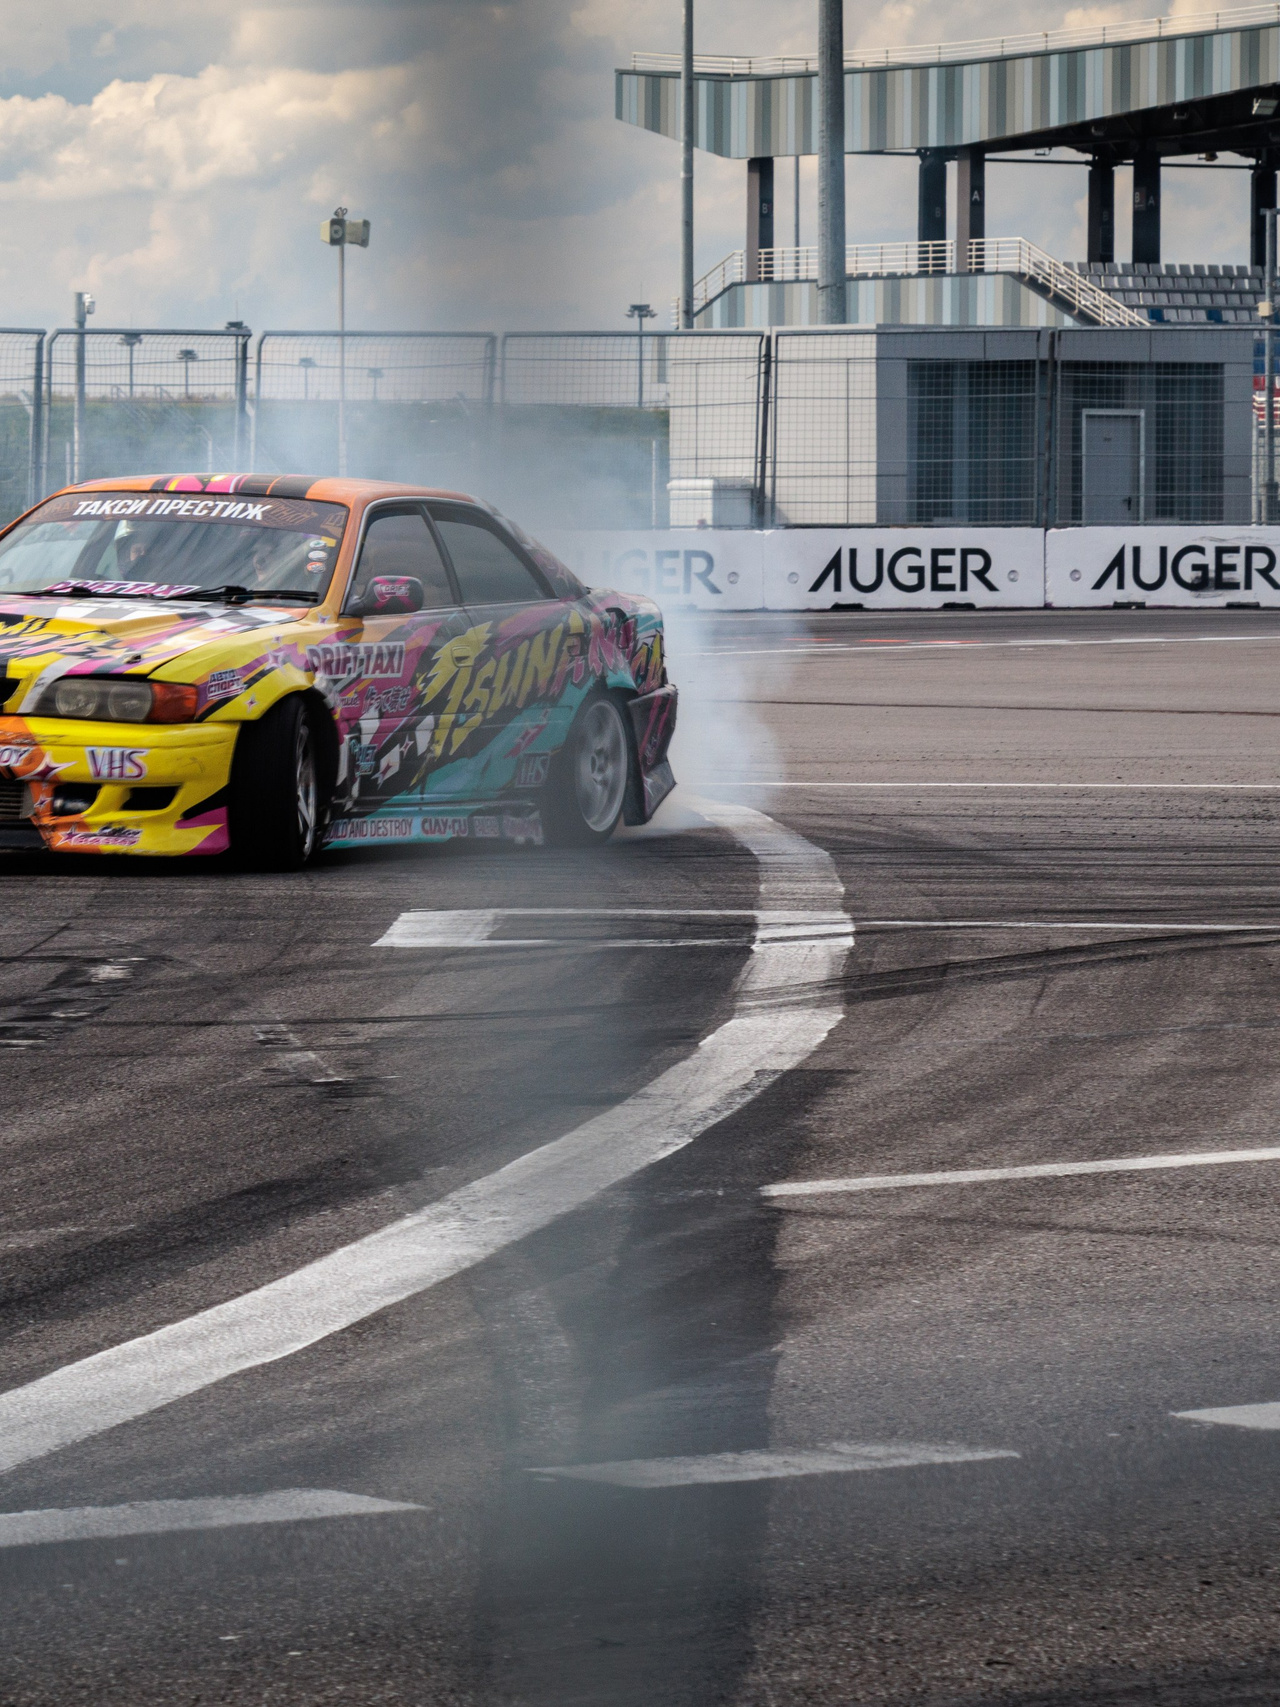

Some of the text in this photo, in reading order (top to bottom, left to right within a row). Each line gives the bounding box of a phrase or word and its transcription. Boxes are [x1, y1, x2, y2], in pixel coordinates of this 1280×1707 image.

[72, 499, 147, 517] ТАКСИ
[145, 498, 272, 521] ПРЕСТИЖ
[808, 545, 1000, 593] AUGER
[1091, 543, 1280, 591] AUGER
[87, 749, 147, 779] VHS
[349, 819, 368, 838] AND
[369, 817, 414, 837] DESTROY
